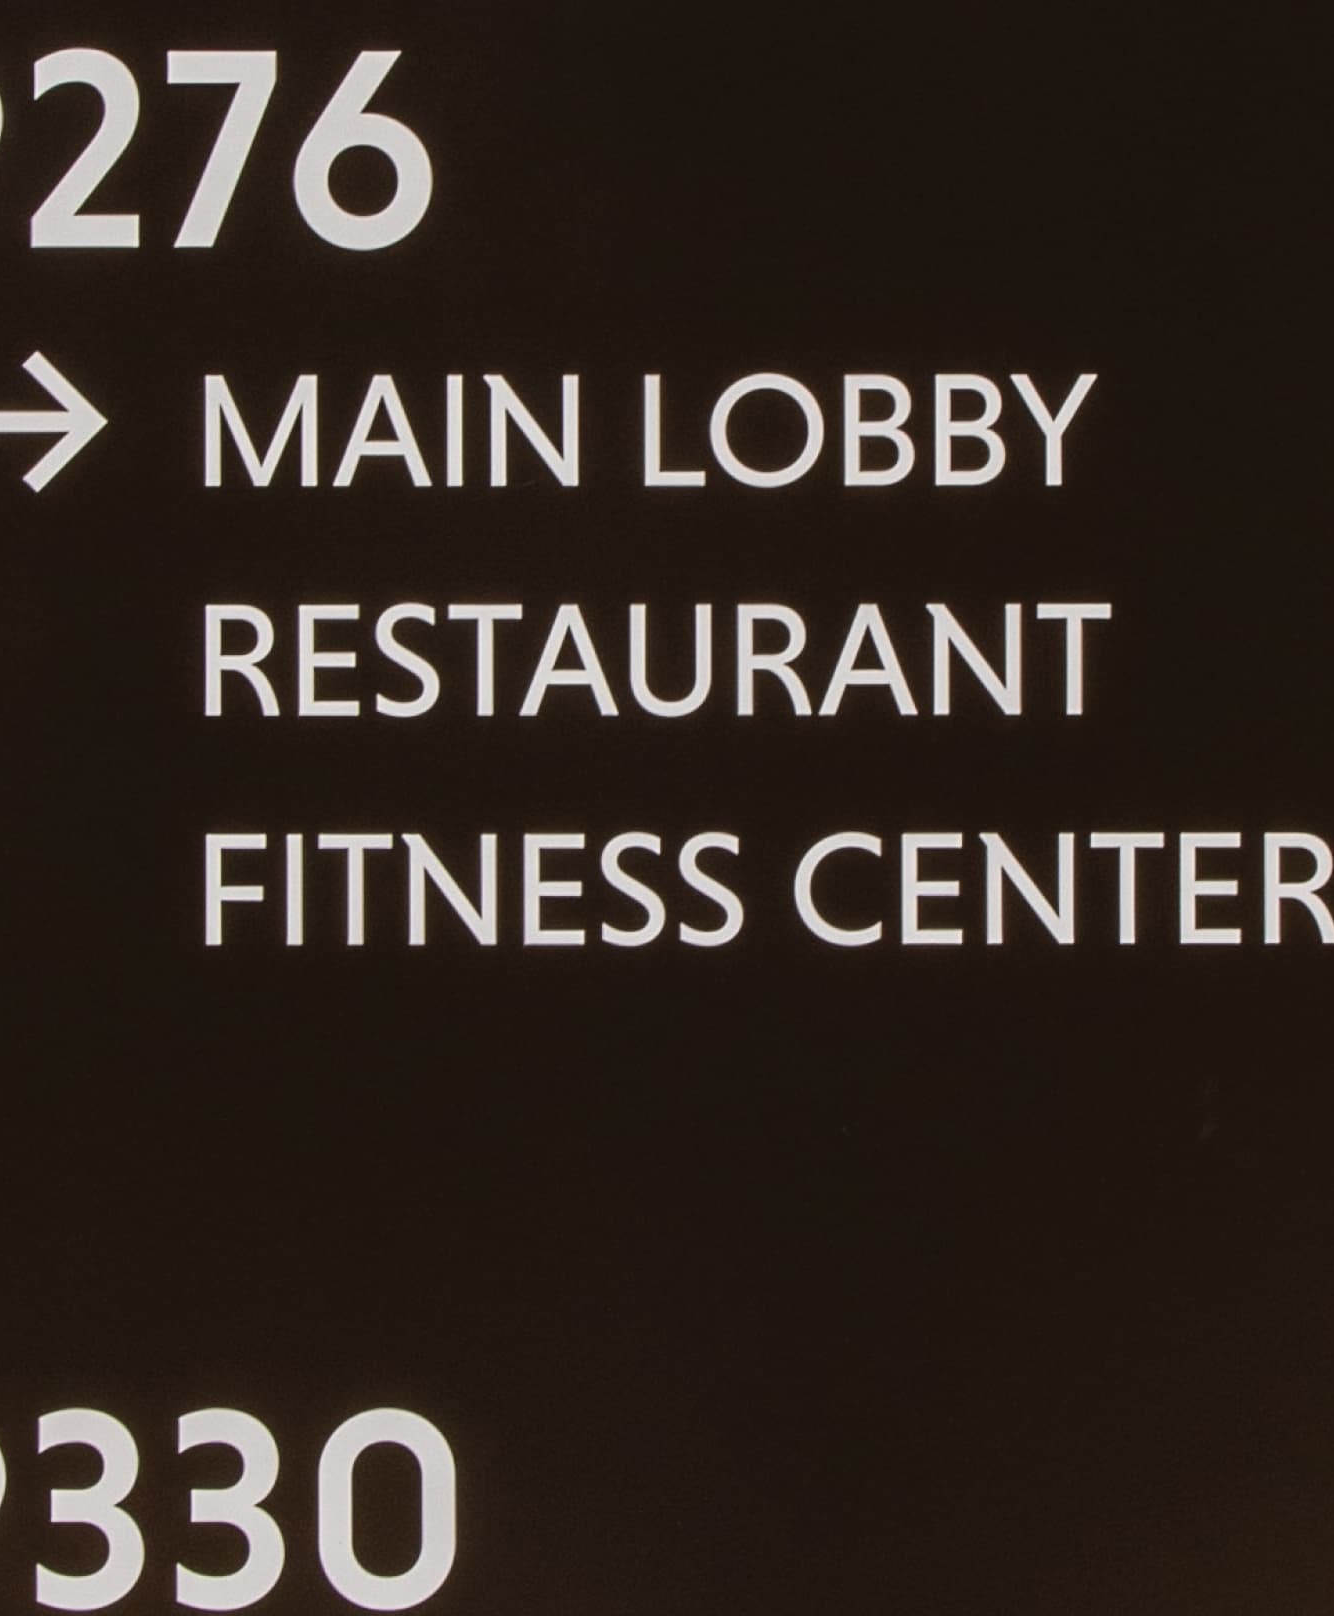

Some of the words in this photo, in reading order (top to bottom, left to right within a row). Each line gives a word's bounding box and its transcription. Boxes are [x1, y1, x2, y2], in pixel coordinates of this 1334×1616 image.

[203, 373, 580, 488] MAIN
[643, 372, 1099, 489] LOBBY
[204, 601, 1113, 719] RESTAURANT
[204, 831, 745, 948] FITNESS
